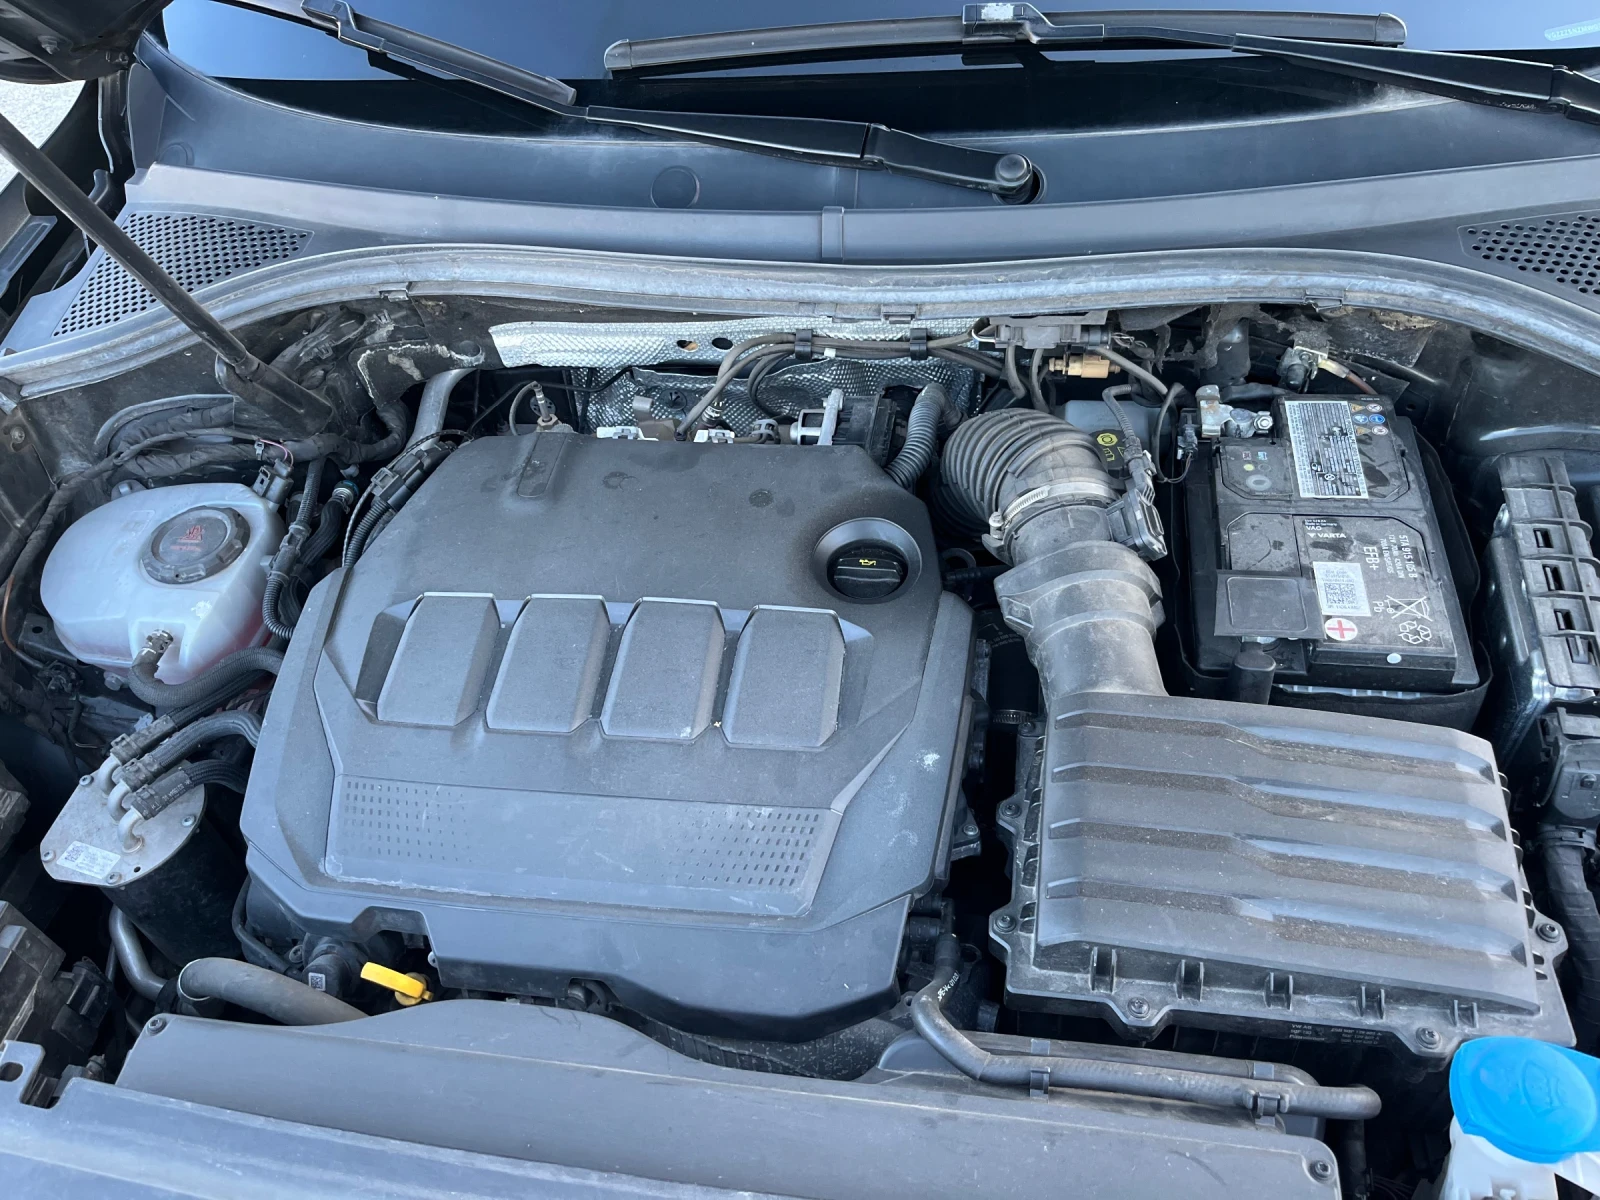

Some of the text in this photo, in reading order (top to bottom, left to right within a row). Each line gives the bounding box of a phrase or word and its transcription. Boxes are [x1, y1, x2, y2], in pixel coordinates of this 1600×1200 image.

[1363, 546, 1380, 570] EFB+
[1402, 547, 1413, 559] 915
[1373, 601, 1384, 612] Pb
